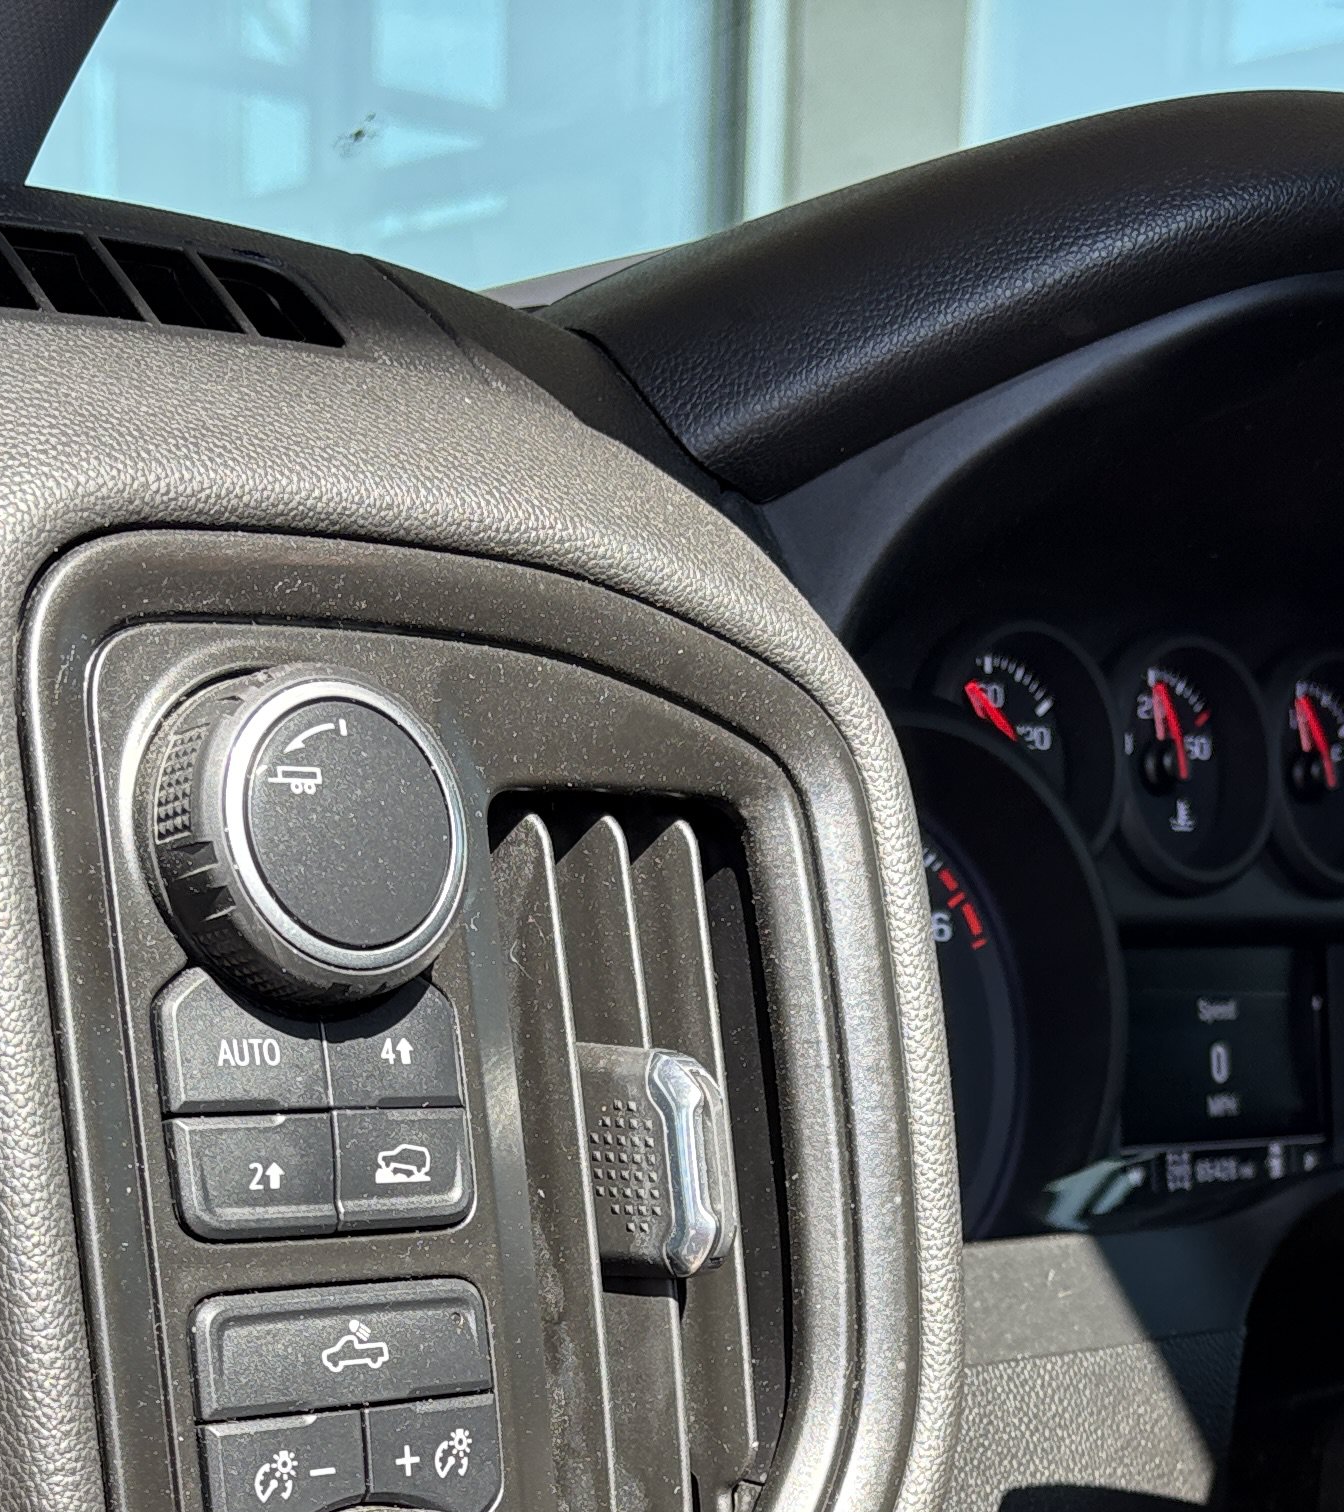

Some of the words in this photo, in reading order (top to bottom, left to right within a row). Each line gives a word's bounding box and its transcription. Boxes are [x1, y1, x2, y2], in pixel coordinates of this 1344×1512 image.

[931, 911, 953, 943] 6
[217, 1039, 281, 1067] AUTO
[380, 1041, 396, 1065] 4
[249, 1163, 264, 1190] 2
